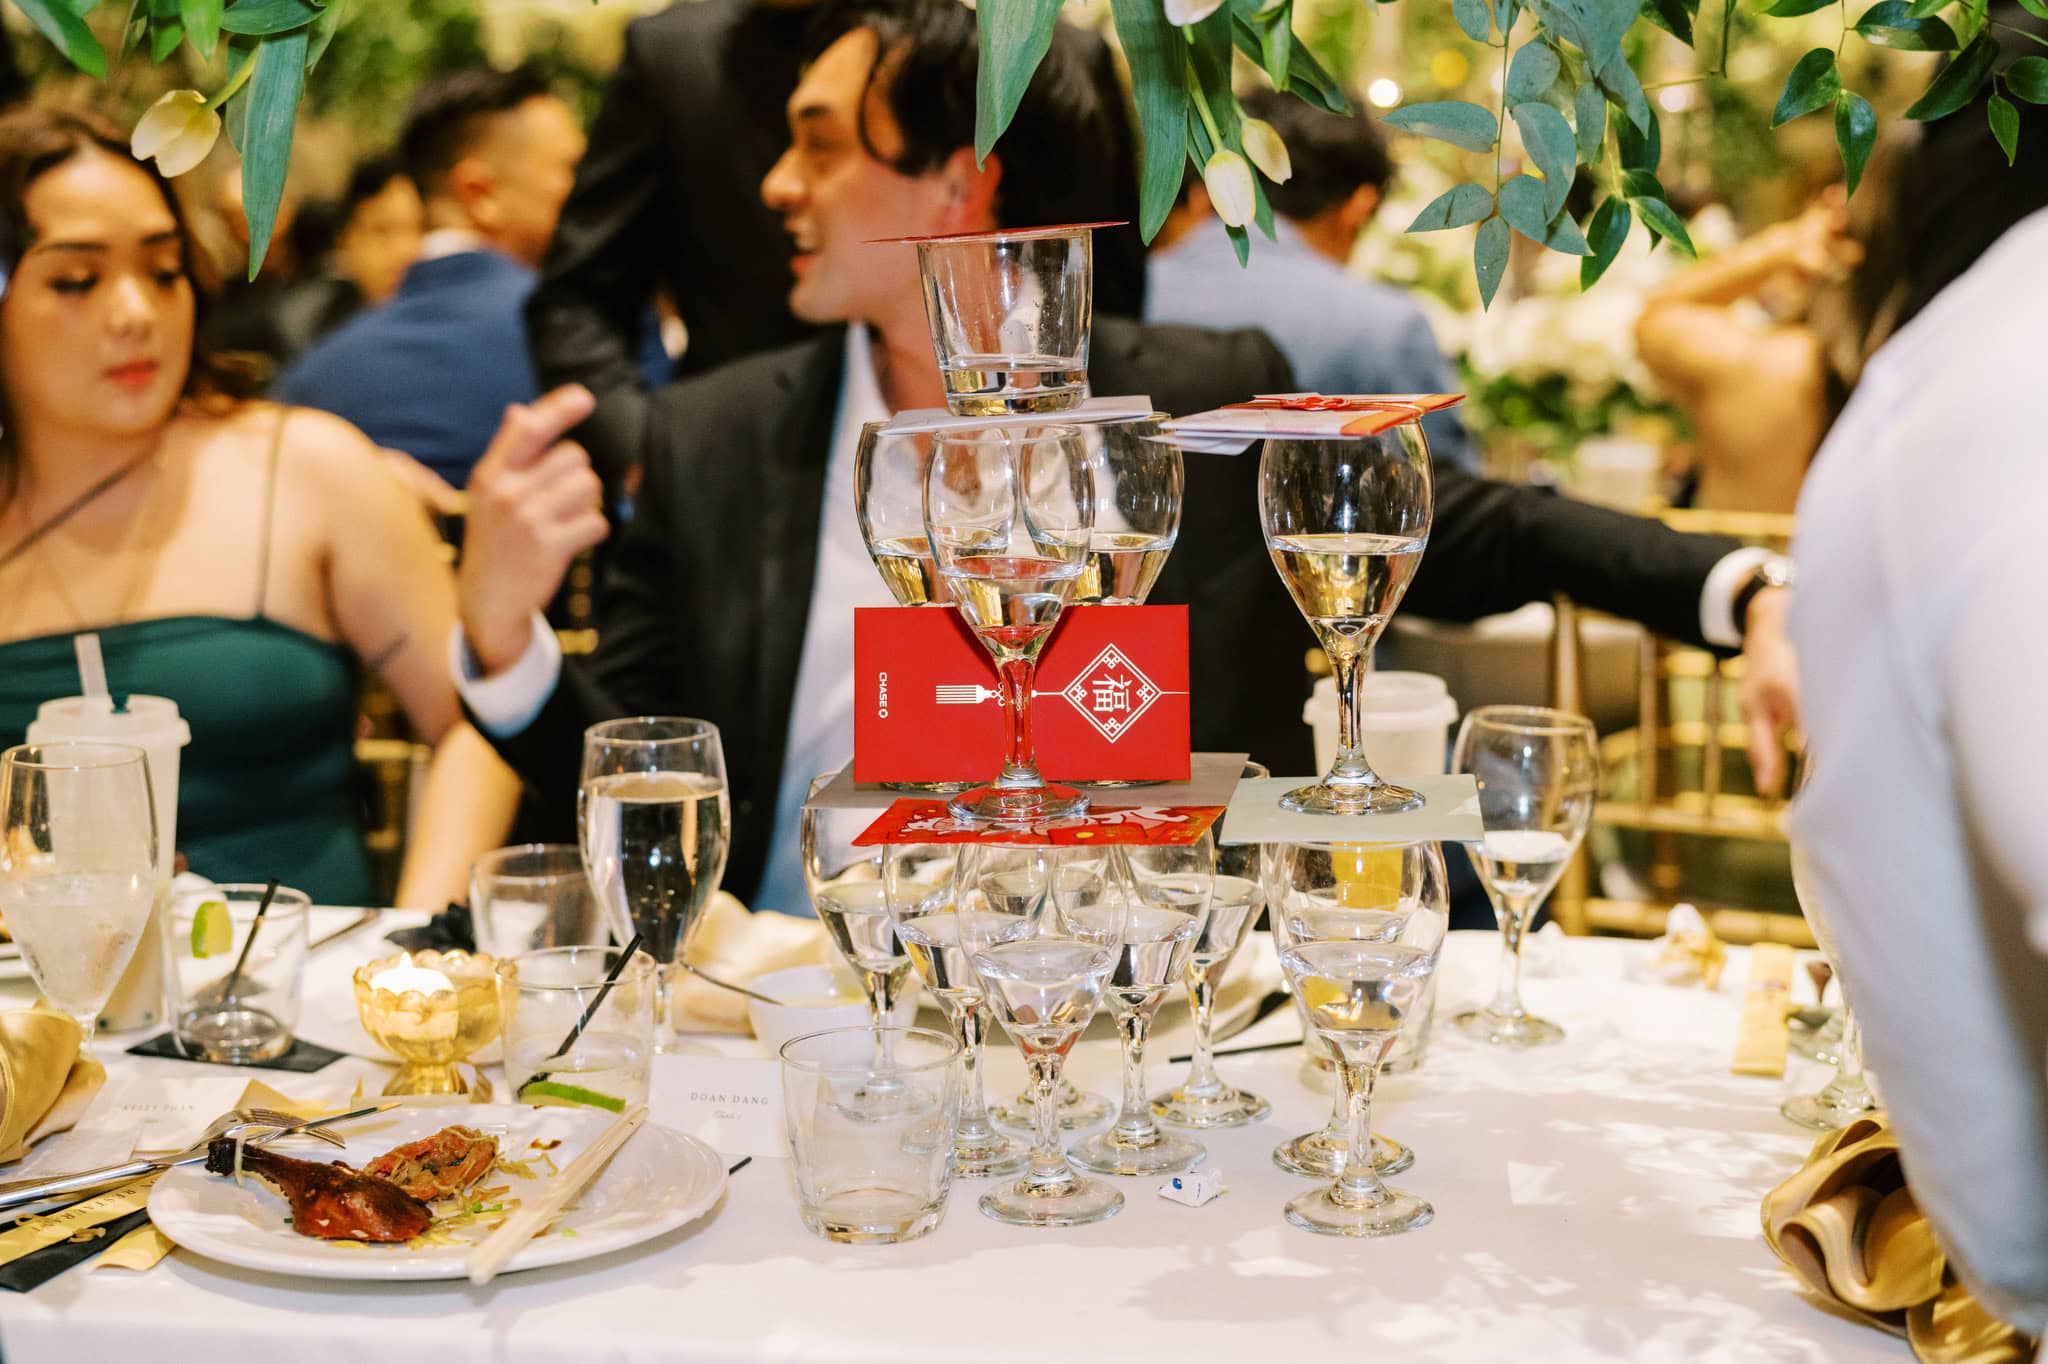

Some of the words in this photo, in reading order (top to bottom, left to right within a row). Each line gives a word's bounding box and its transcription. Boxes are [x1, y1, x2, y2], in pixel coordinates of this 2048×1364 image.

[878, 672, 888, 708] CHASE
[1092, 673, 1133, 713] 福
[690, 1092, 727, 1104] DOAN
[732, 1095, 769, 1106] DANG
